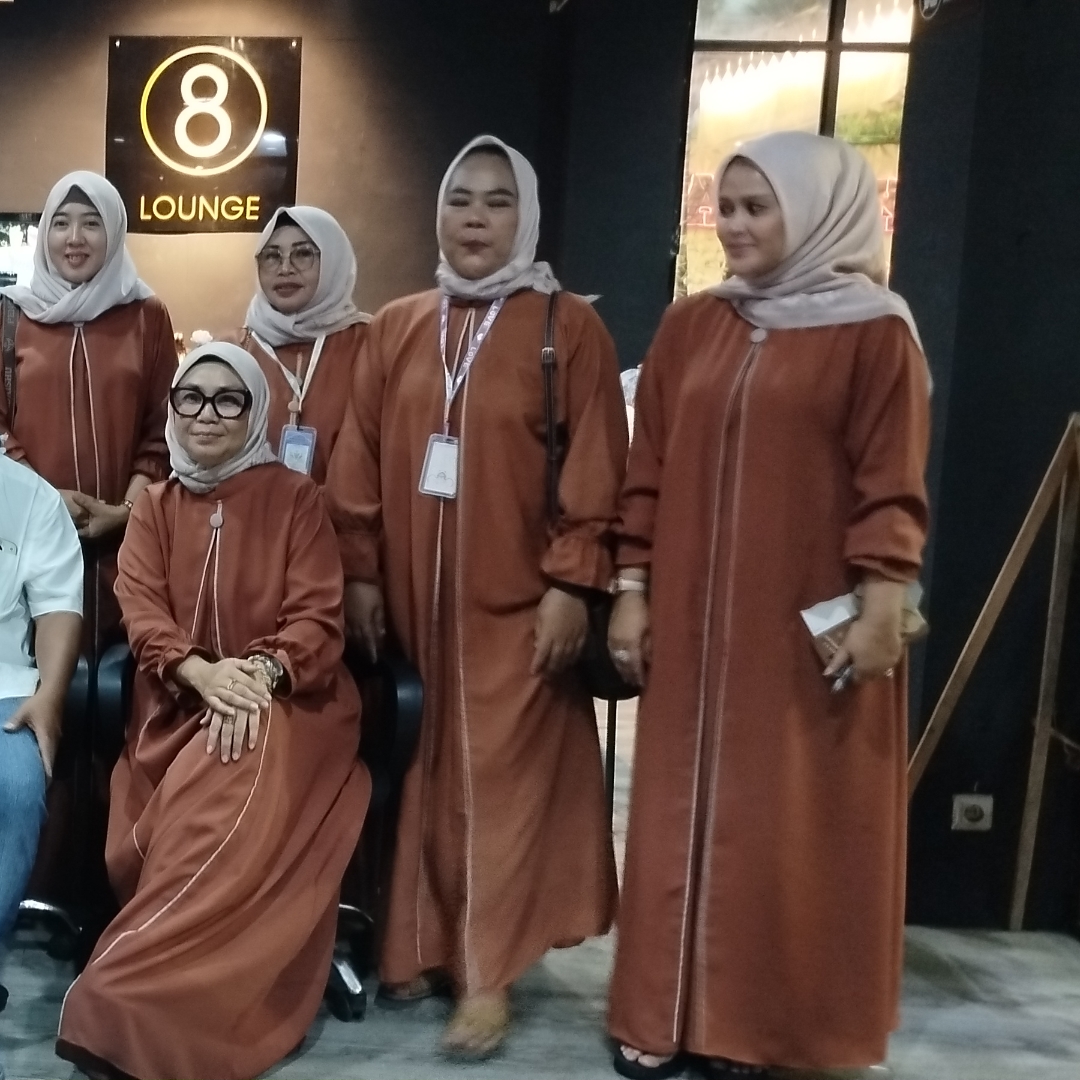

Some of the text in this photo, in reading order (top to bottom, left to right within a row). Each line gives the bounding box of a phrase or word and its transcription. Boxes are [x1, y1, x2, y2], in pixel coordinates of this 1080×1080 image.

[175, 63, 232, 158] 8
[139, 194, 261, 221] LOUNGE
[484, 305, 498, 326] LOVE
[463, 346, 476, 368] LOVE
